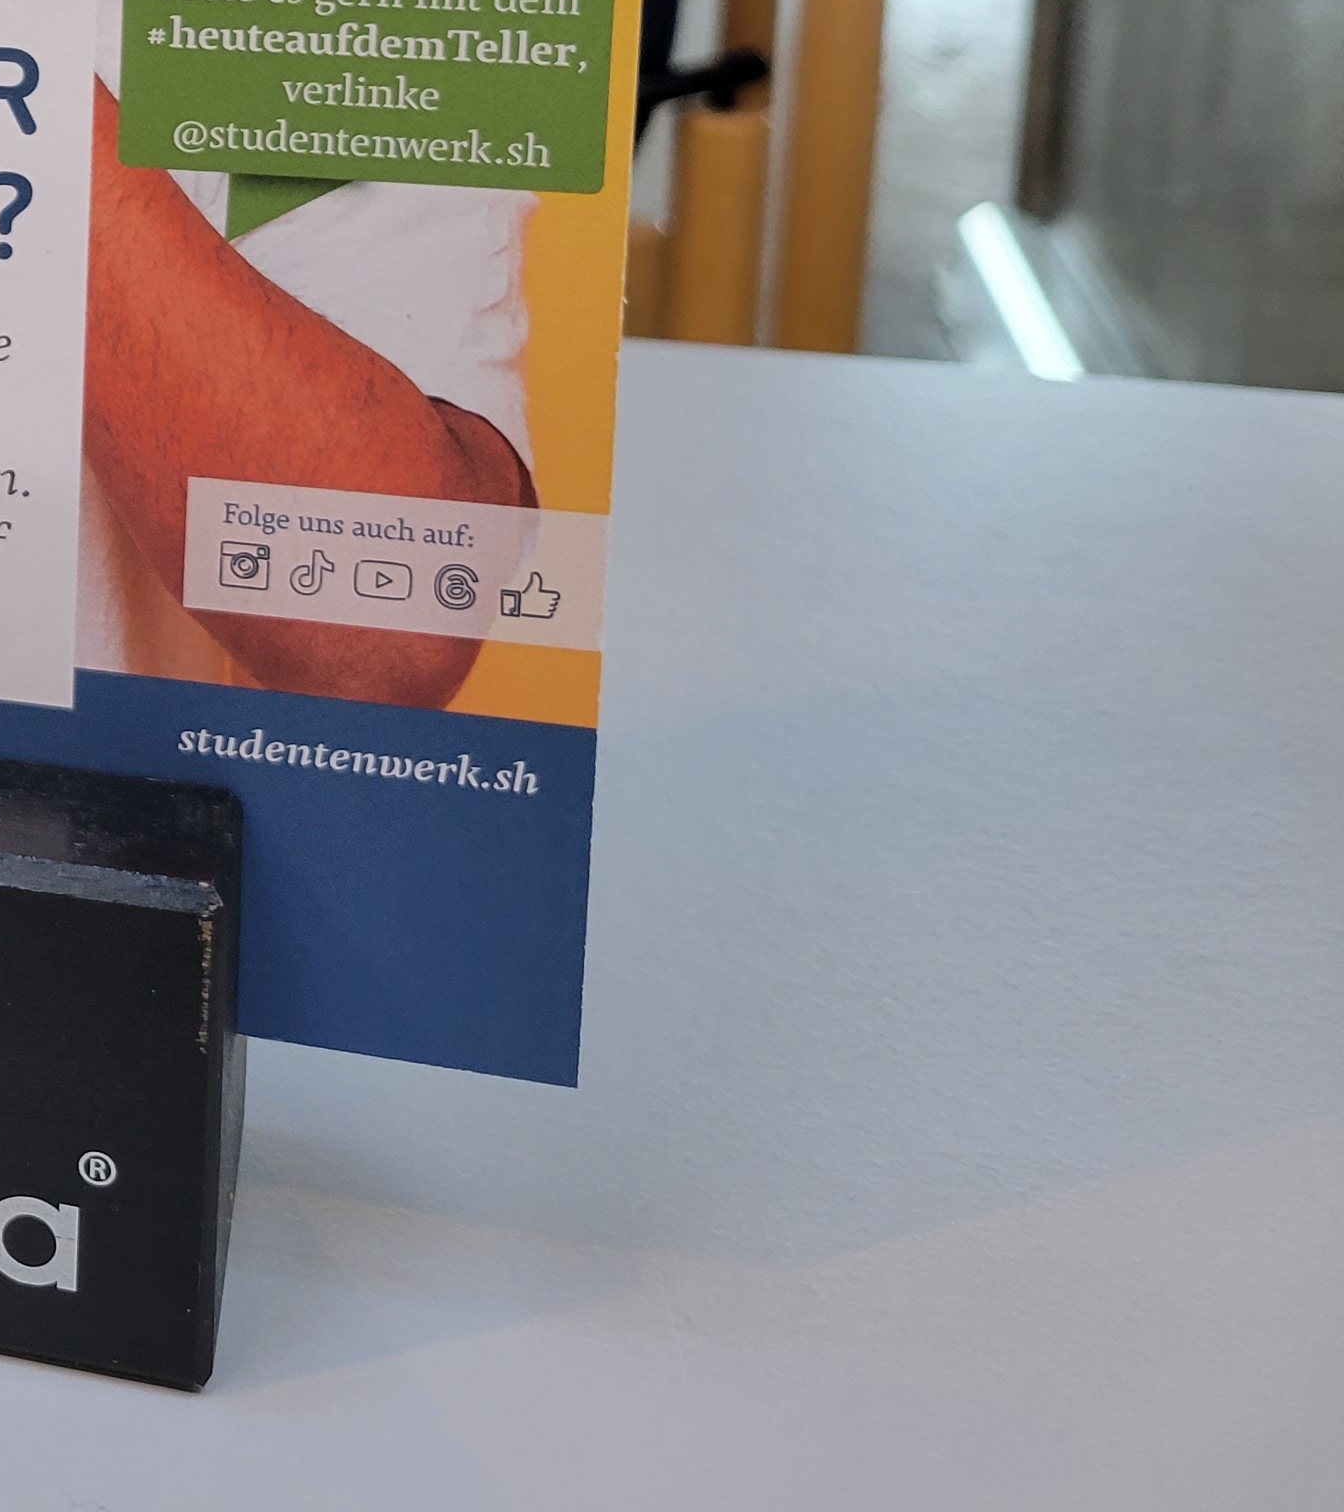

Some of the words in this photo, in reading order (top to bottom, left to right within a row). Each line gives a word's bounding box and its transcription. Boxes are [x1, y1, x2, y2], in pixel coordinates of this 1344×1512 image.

[147, 15, 588, 73] #heuteaufdemTeller,
[282, 74, 440, 111] verlinke
[173, 119, 551, 168] @studentenwerk.sh
[222, 503, 289, 534] Folge
[298, 515, 343, 535] uns
[352, 518, 414, 542] auch
[423, 525, 475, 546] auf:
[178, 728, 538, 795] studentenwerk.sh
